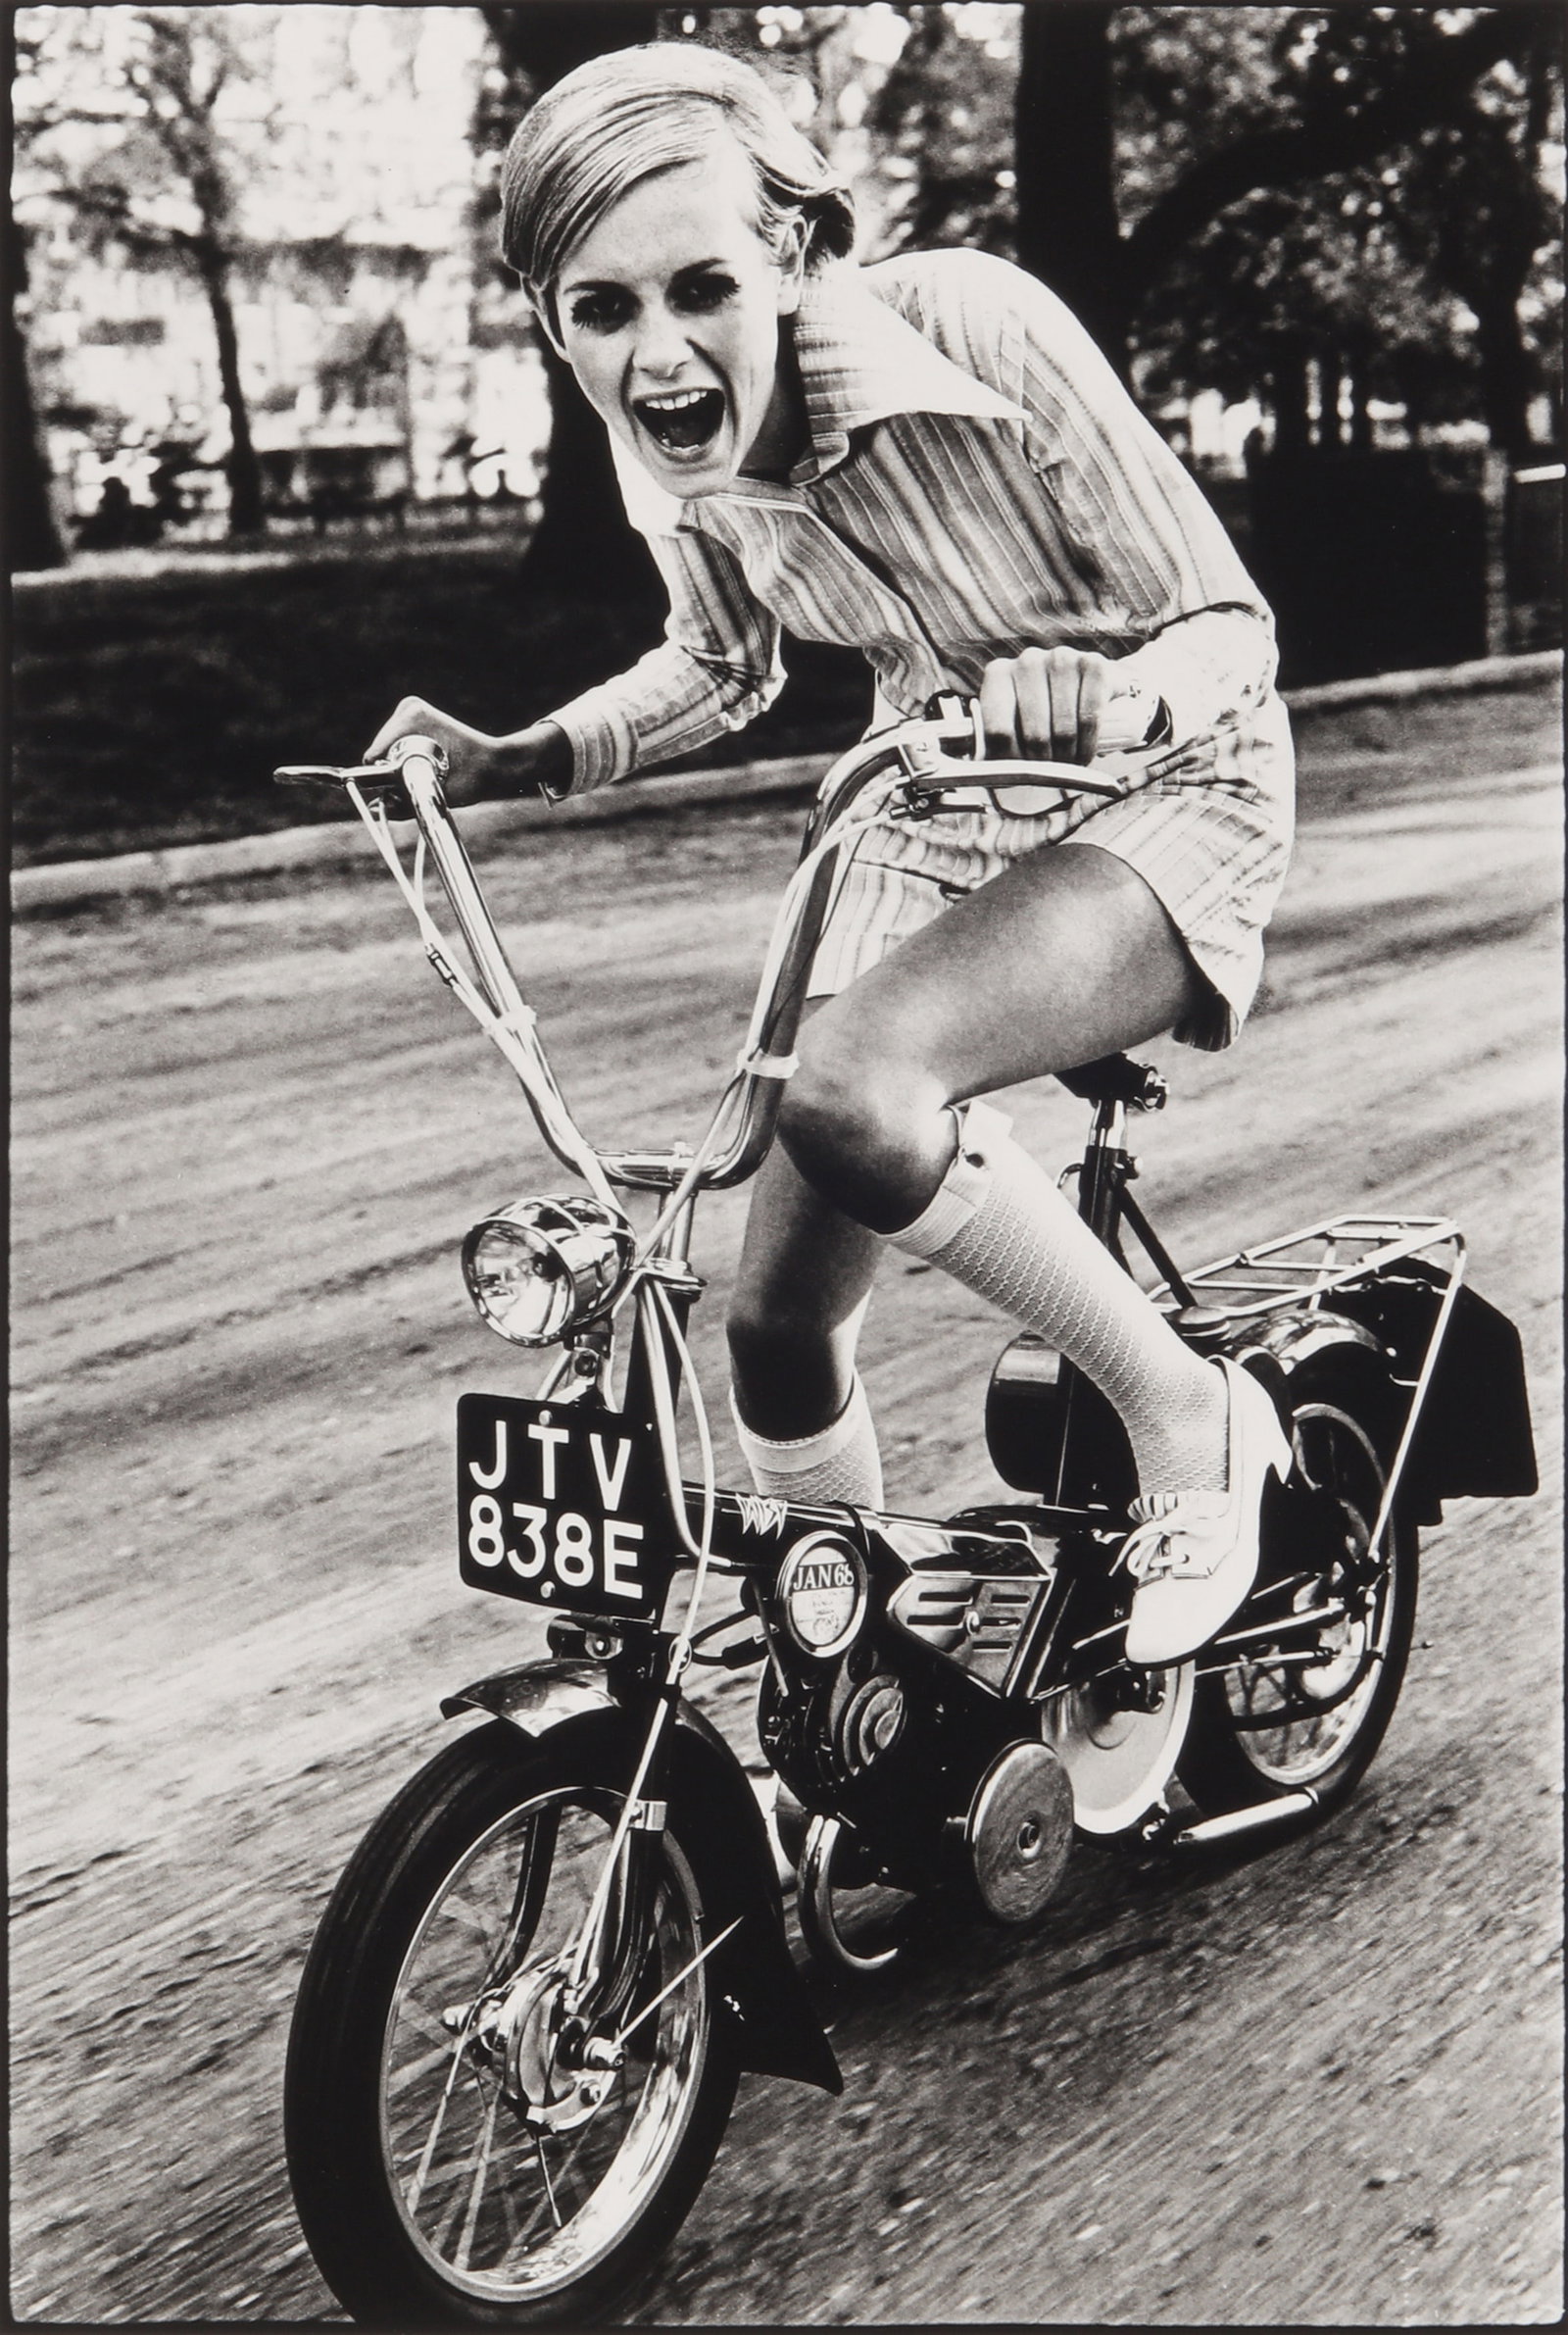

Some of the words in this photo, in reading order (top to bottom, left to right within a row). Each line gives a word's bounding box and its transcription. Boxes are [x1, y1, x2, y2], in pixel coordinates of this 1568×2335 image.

[468, 1419, 632, 1512] JTV
[468, 1494, 644, 1599] 838E
[793, 1565, 832, 1590] JAN
